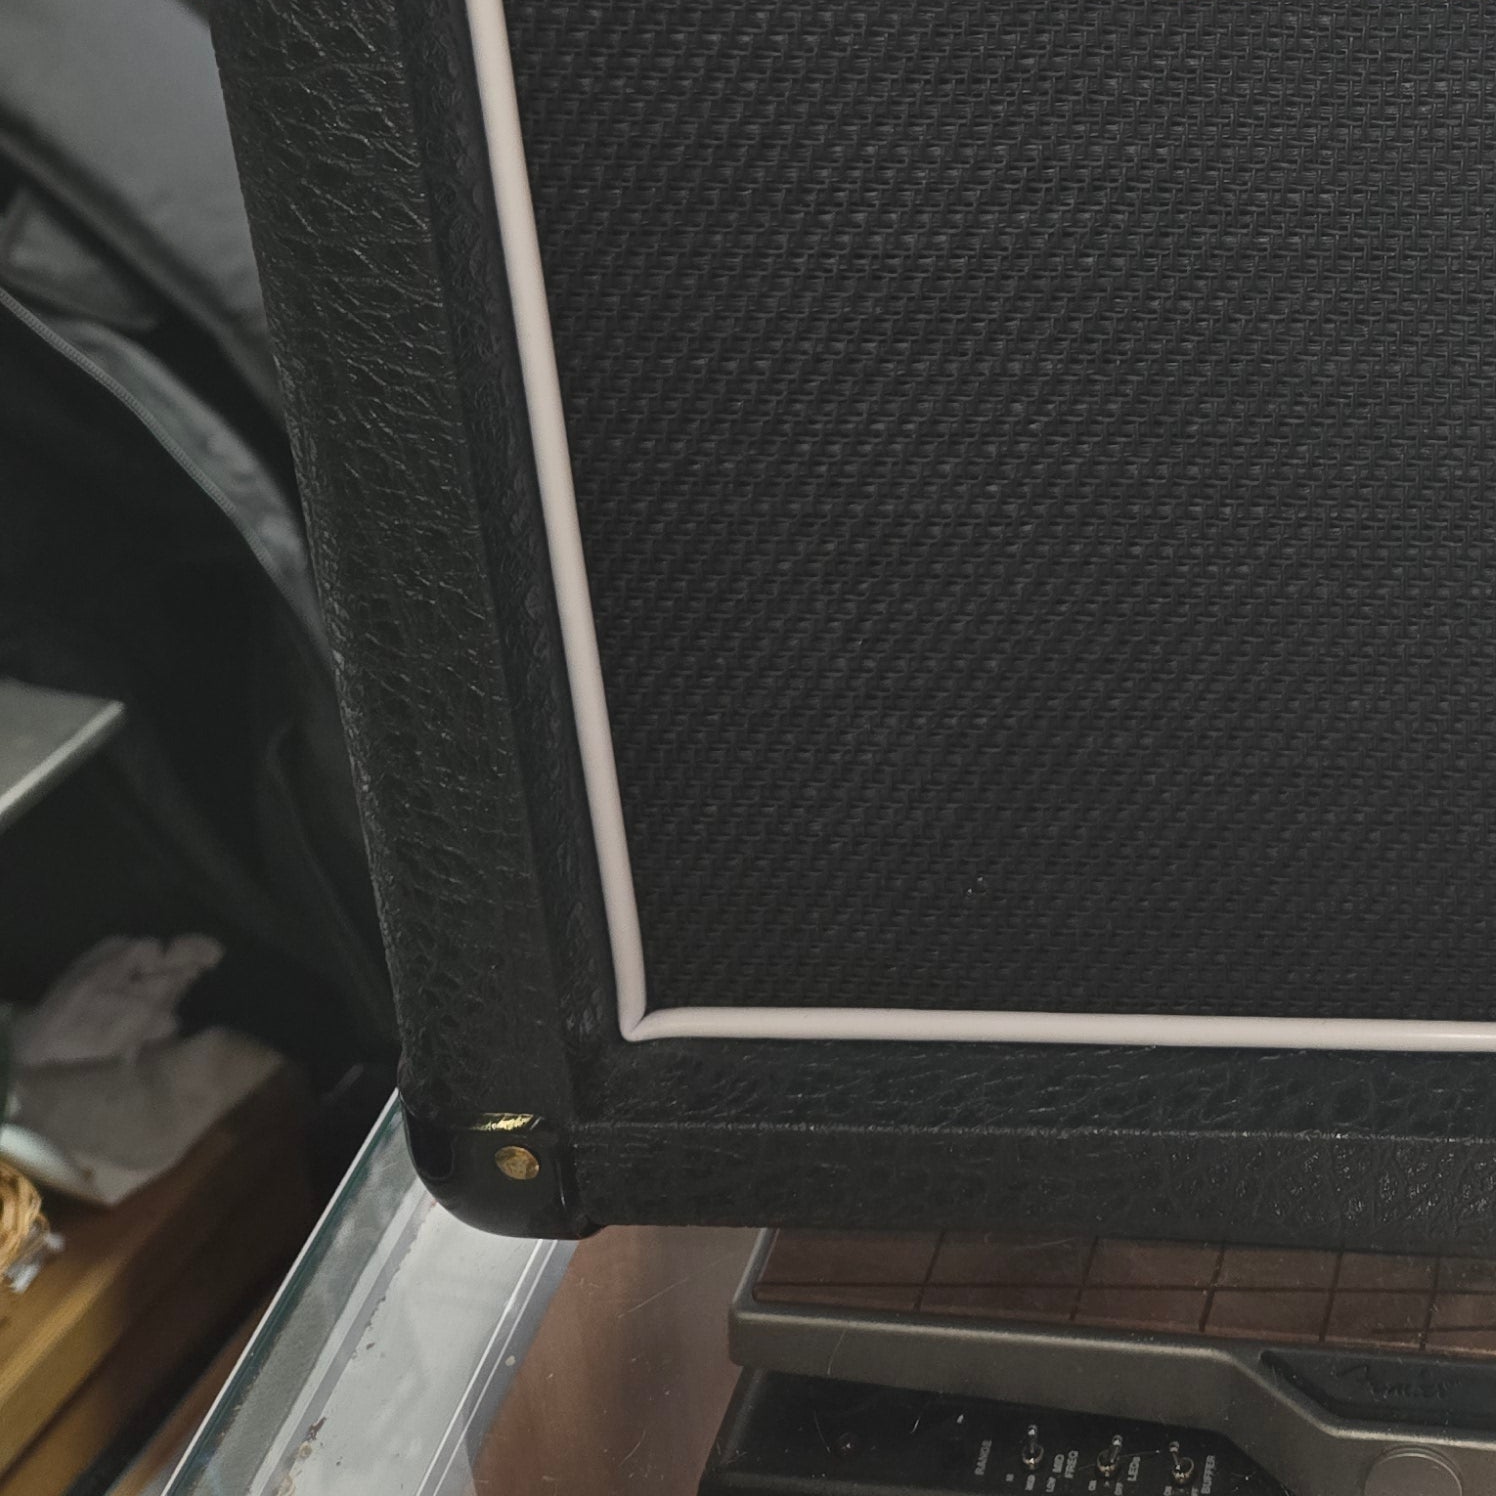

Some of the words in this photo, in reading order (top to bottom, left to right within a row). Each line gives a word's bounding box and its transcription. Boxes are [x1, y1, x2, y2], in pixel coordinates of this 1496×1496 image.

[974, 1439, 992, 1476] RANGE
[1052, 1454, 1065, 1473] MID
[1064, 1450, 1079, 1478] FREQ
[1201, 1455, 1216, 1495] BUFFER
